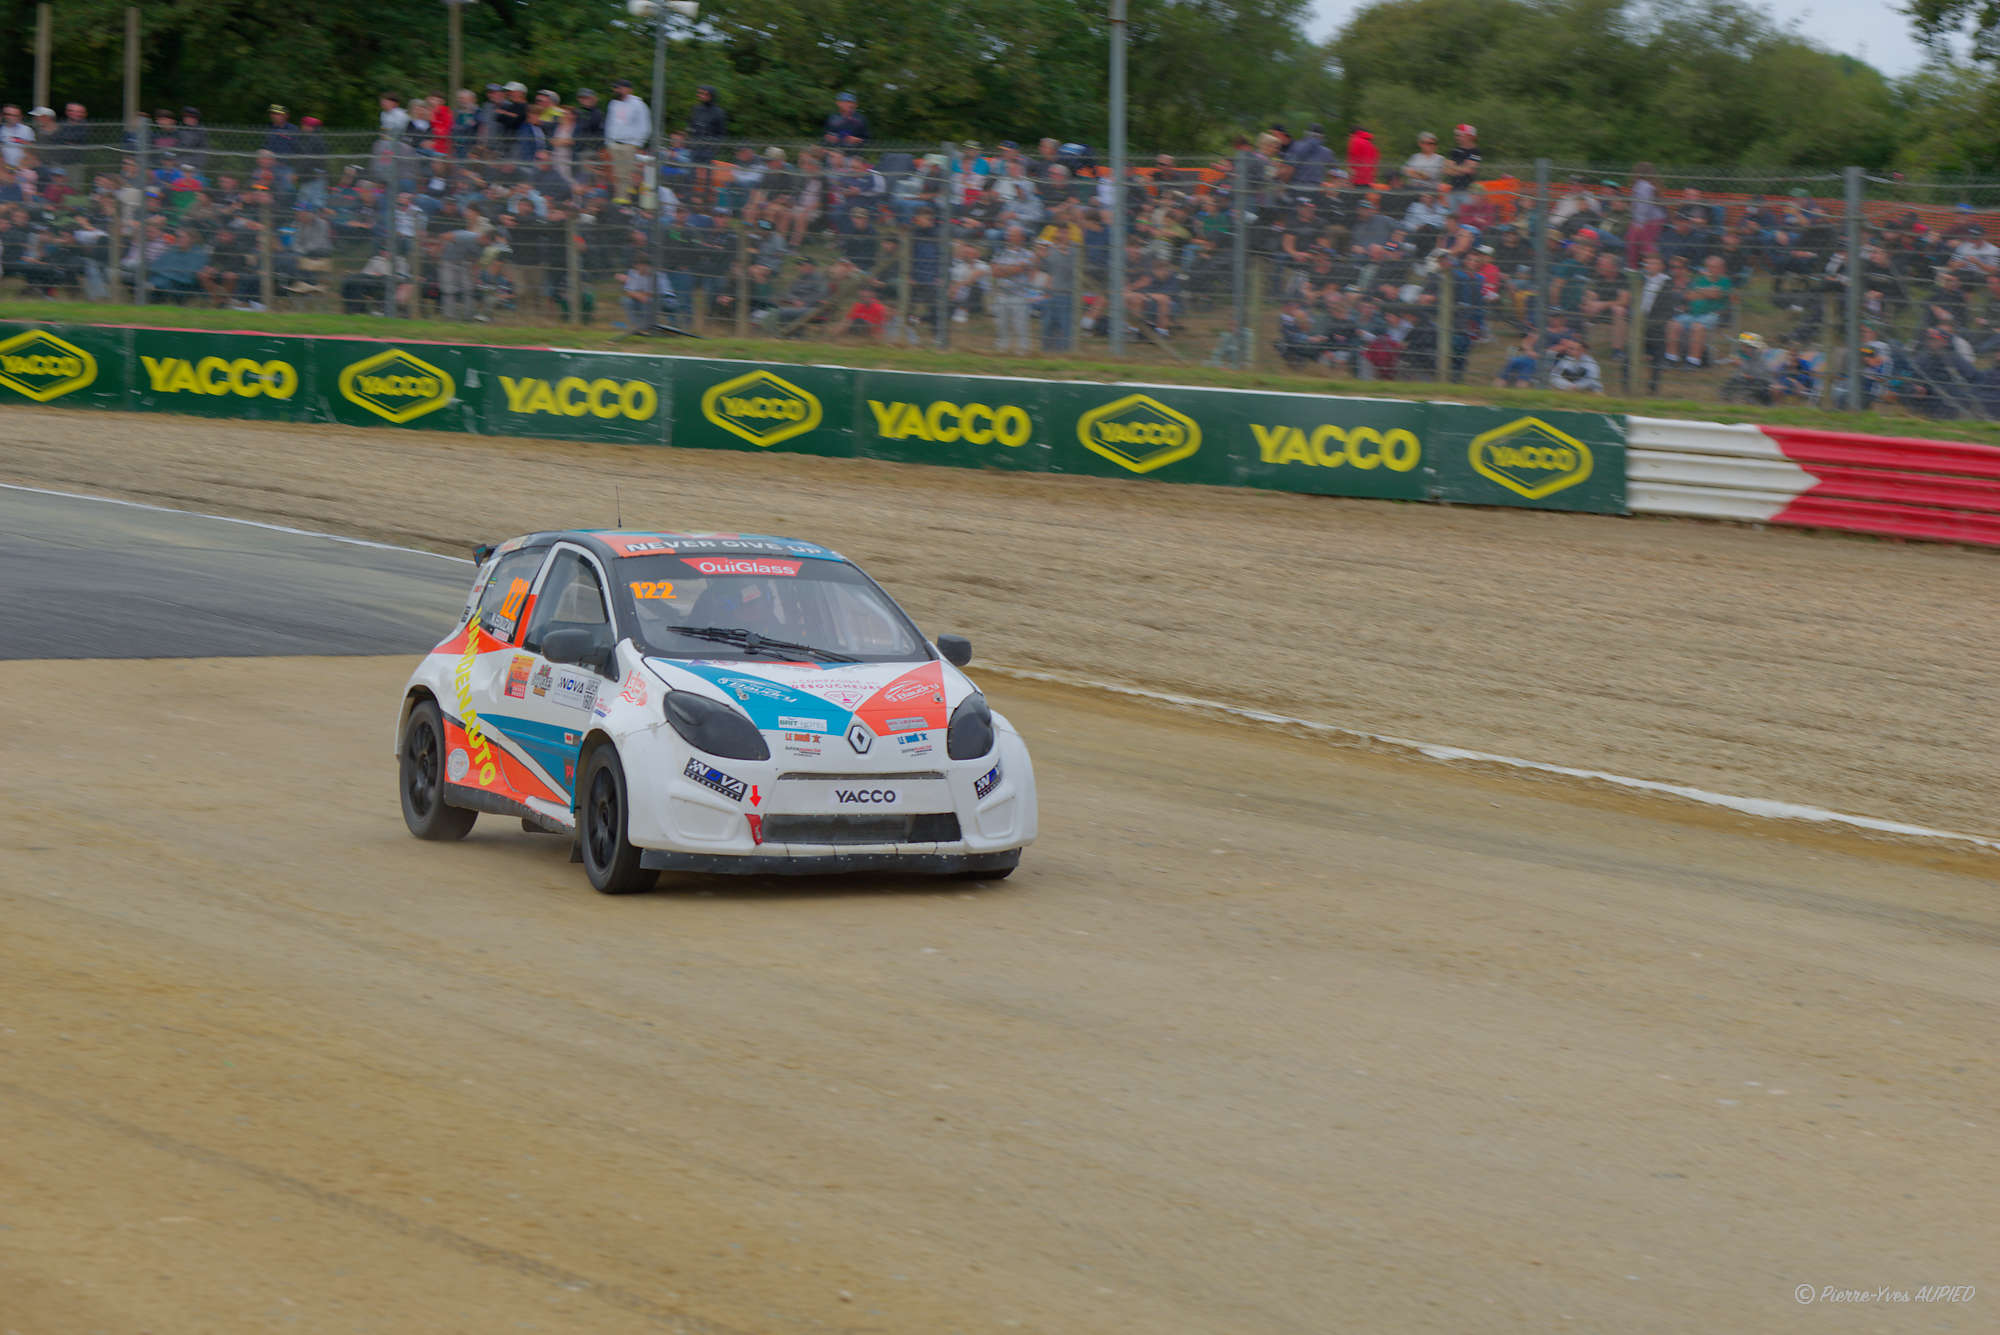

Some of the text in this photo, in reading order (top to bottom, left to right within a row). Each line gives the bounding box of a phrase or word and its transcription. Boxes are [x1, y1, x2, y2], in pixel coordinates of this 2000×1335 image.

[1, 354, 79, 377] YACCO
[139, 354, 298, 400] YACCO
[357, 375, 439, 398] YACCO
[499, 375, 658, 421] YACCO
[719, 396, 803, 421] YACCO
[867, 400, 1032, 447] YACCO
[1096, 421, 1185, 446] YACCO
[1249, 423, 1422, 472] YACCO
[1488, 446, 1578, 471] YACCO
[626, 540, 717, 552] NEVER
[721, 540, 785, 551] GIVE
[700, 560, 796, 575] OuiGlass
[630, 582, 678, 600] 122
[835, 789, 896, 803] YACCO
